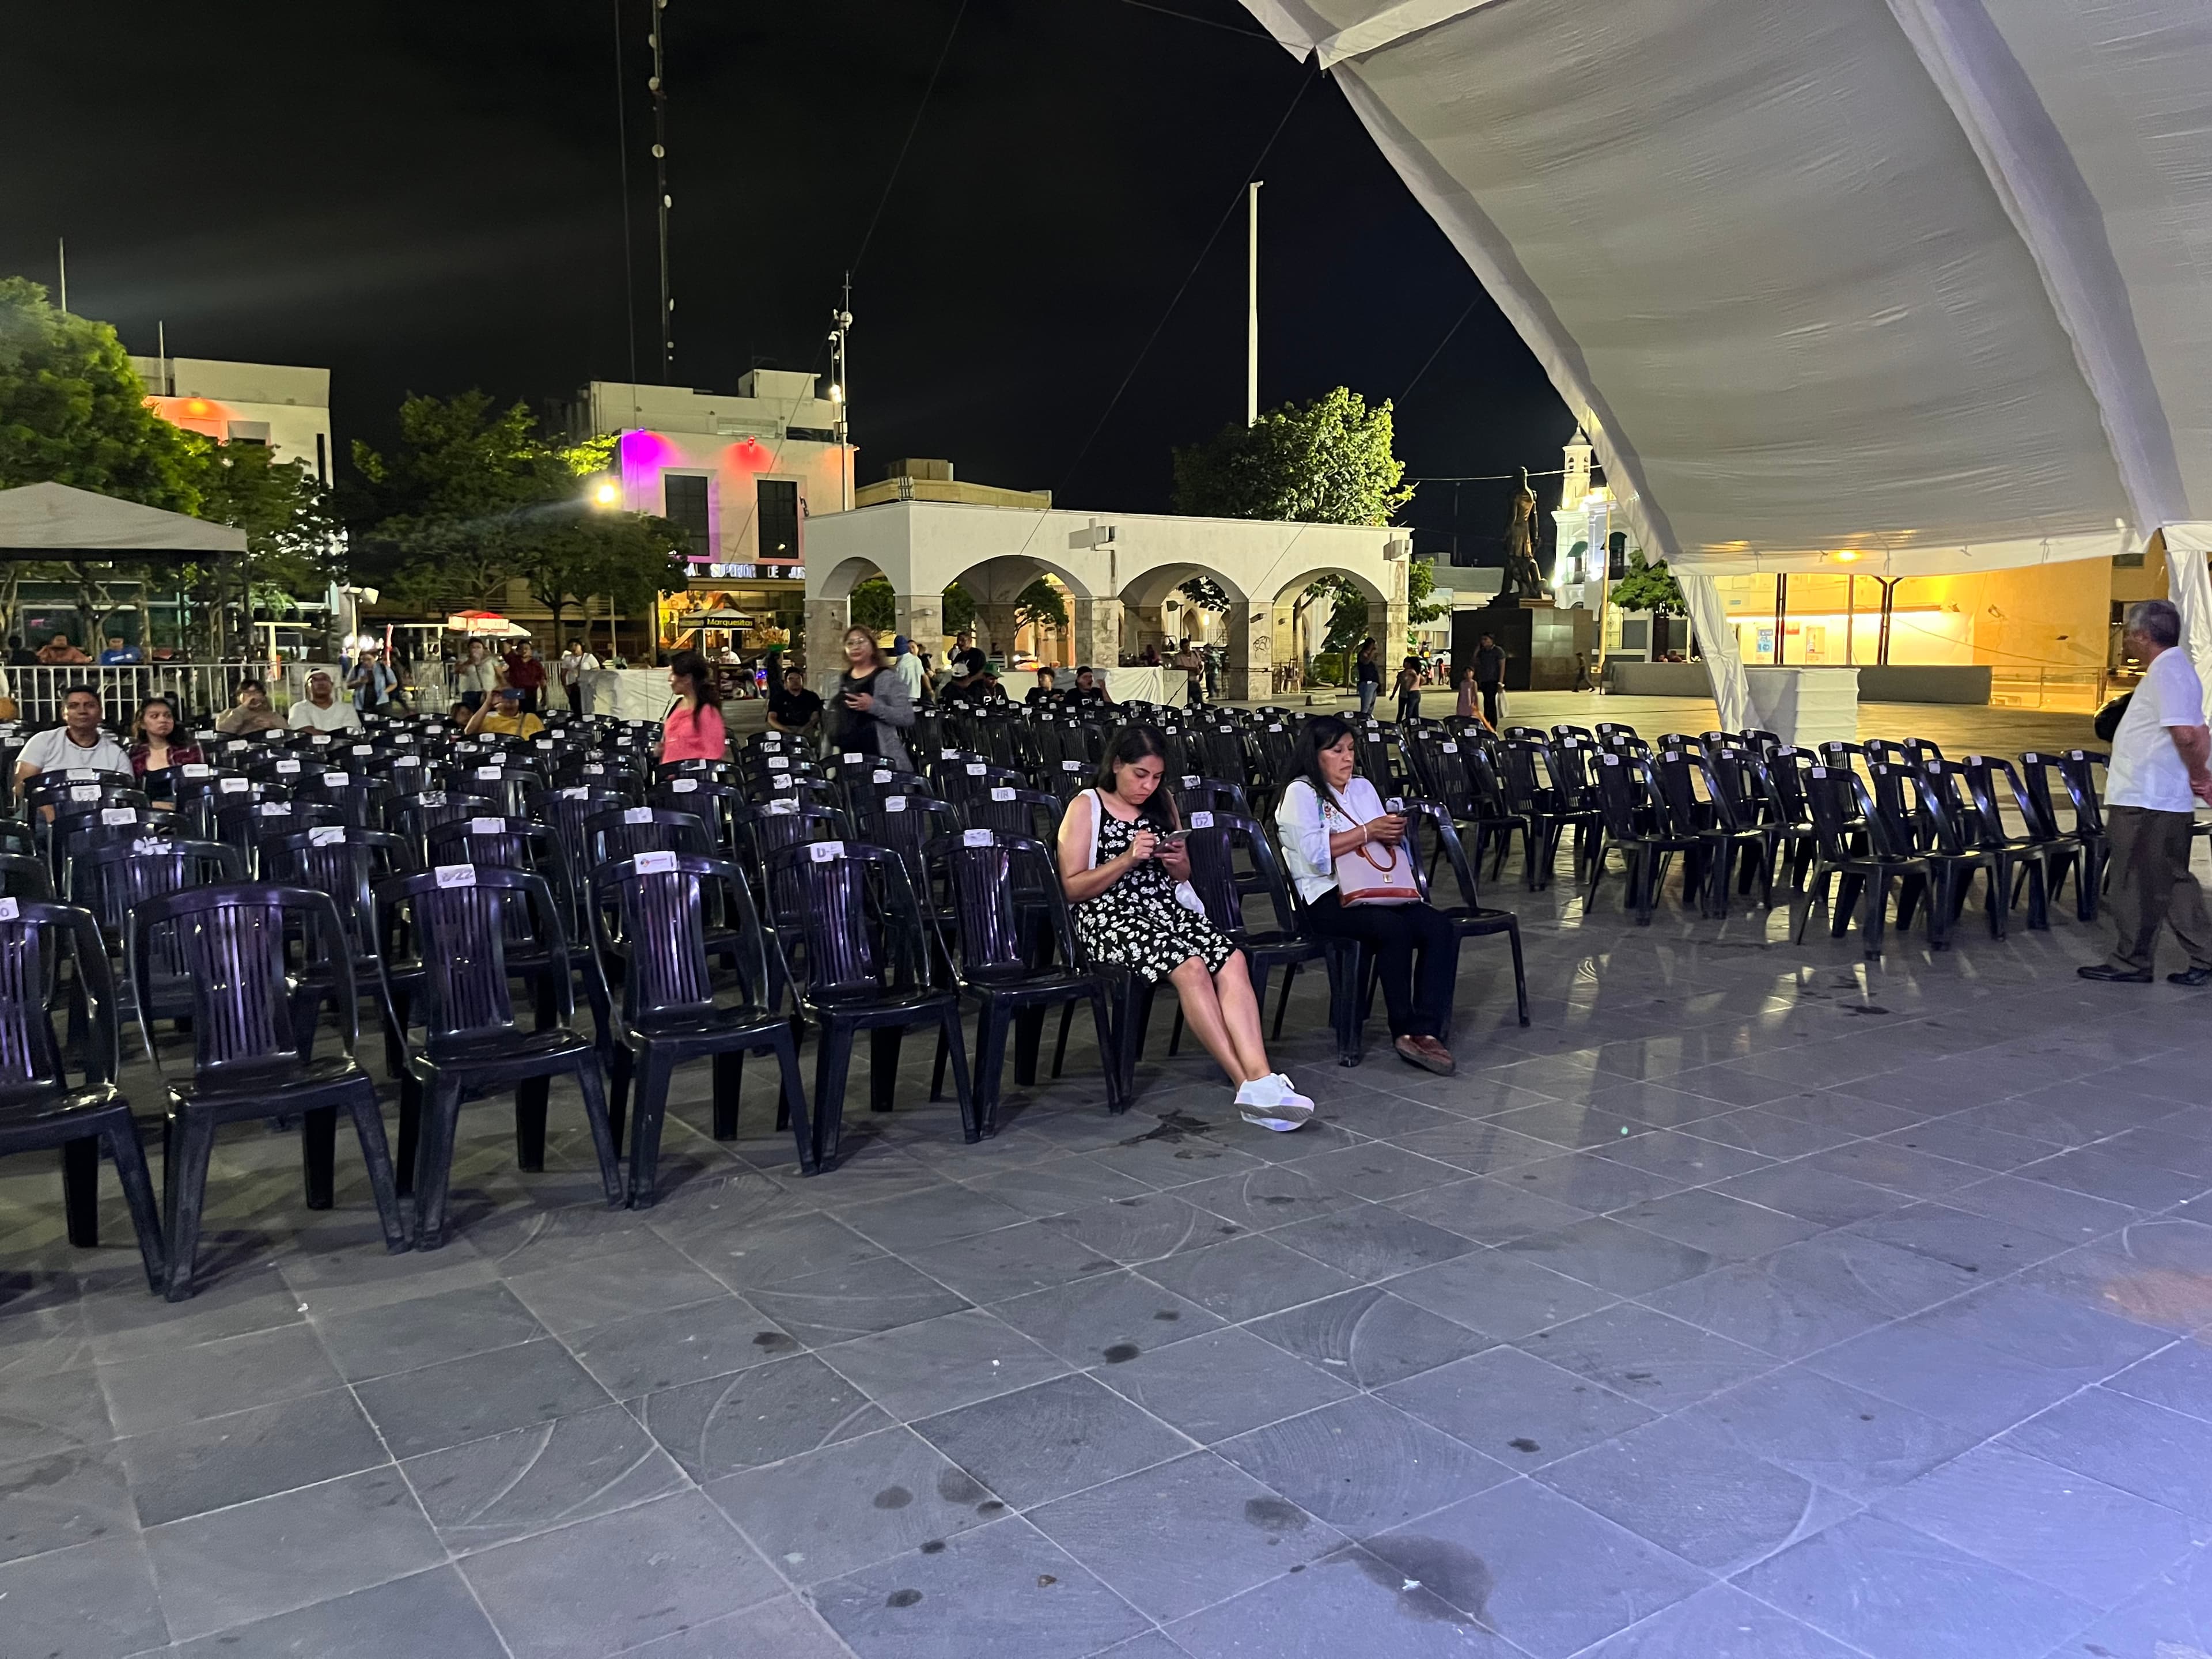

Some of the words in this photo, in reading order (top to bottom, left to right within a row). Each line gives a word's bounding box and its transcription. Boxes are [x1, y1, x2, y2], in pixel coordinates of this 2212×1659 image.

[684, 562, 701, 577] AL
[767, 565, 779, 578] DE
[706, 618, 753, 626] Marquesitas
